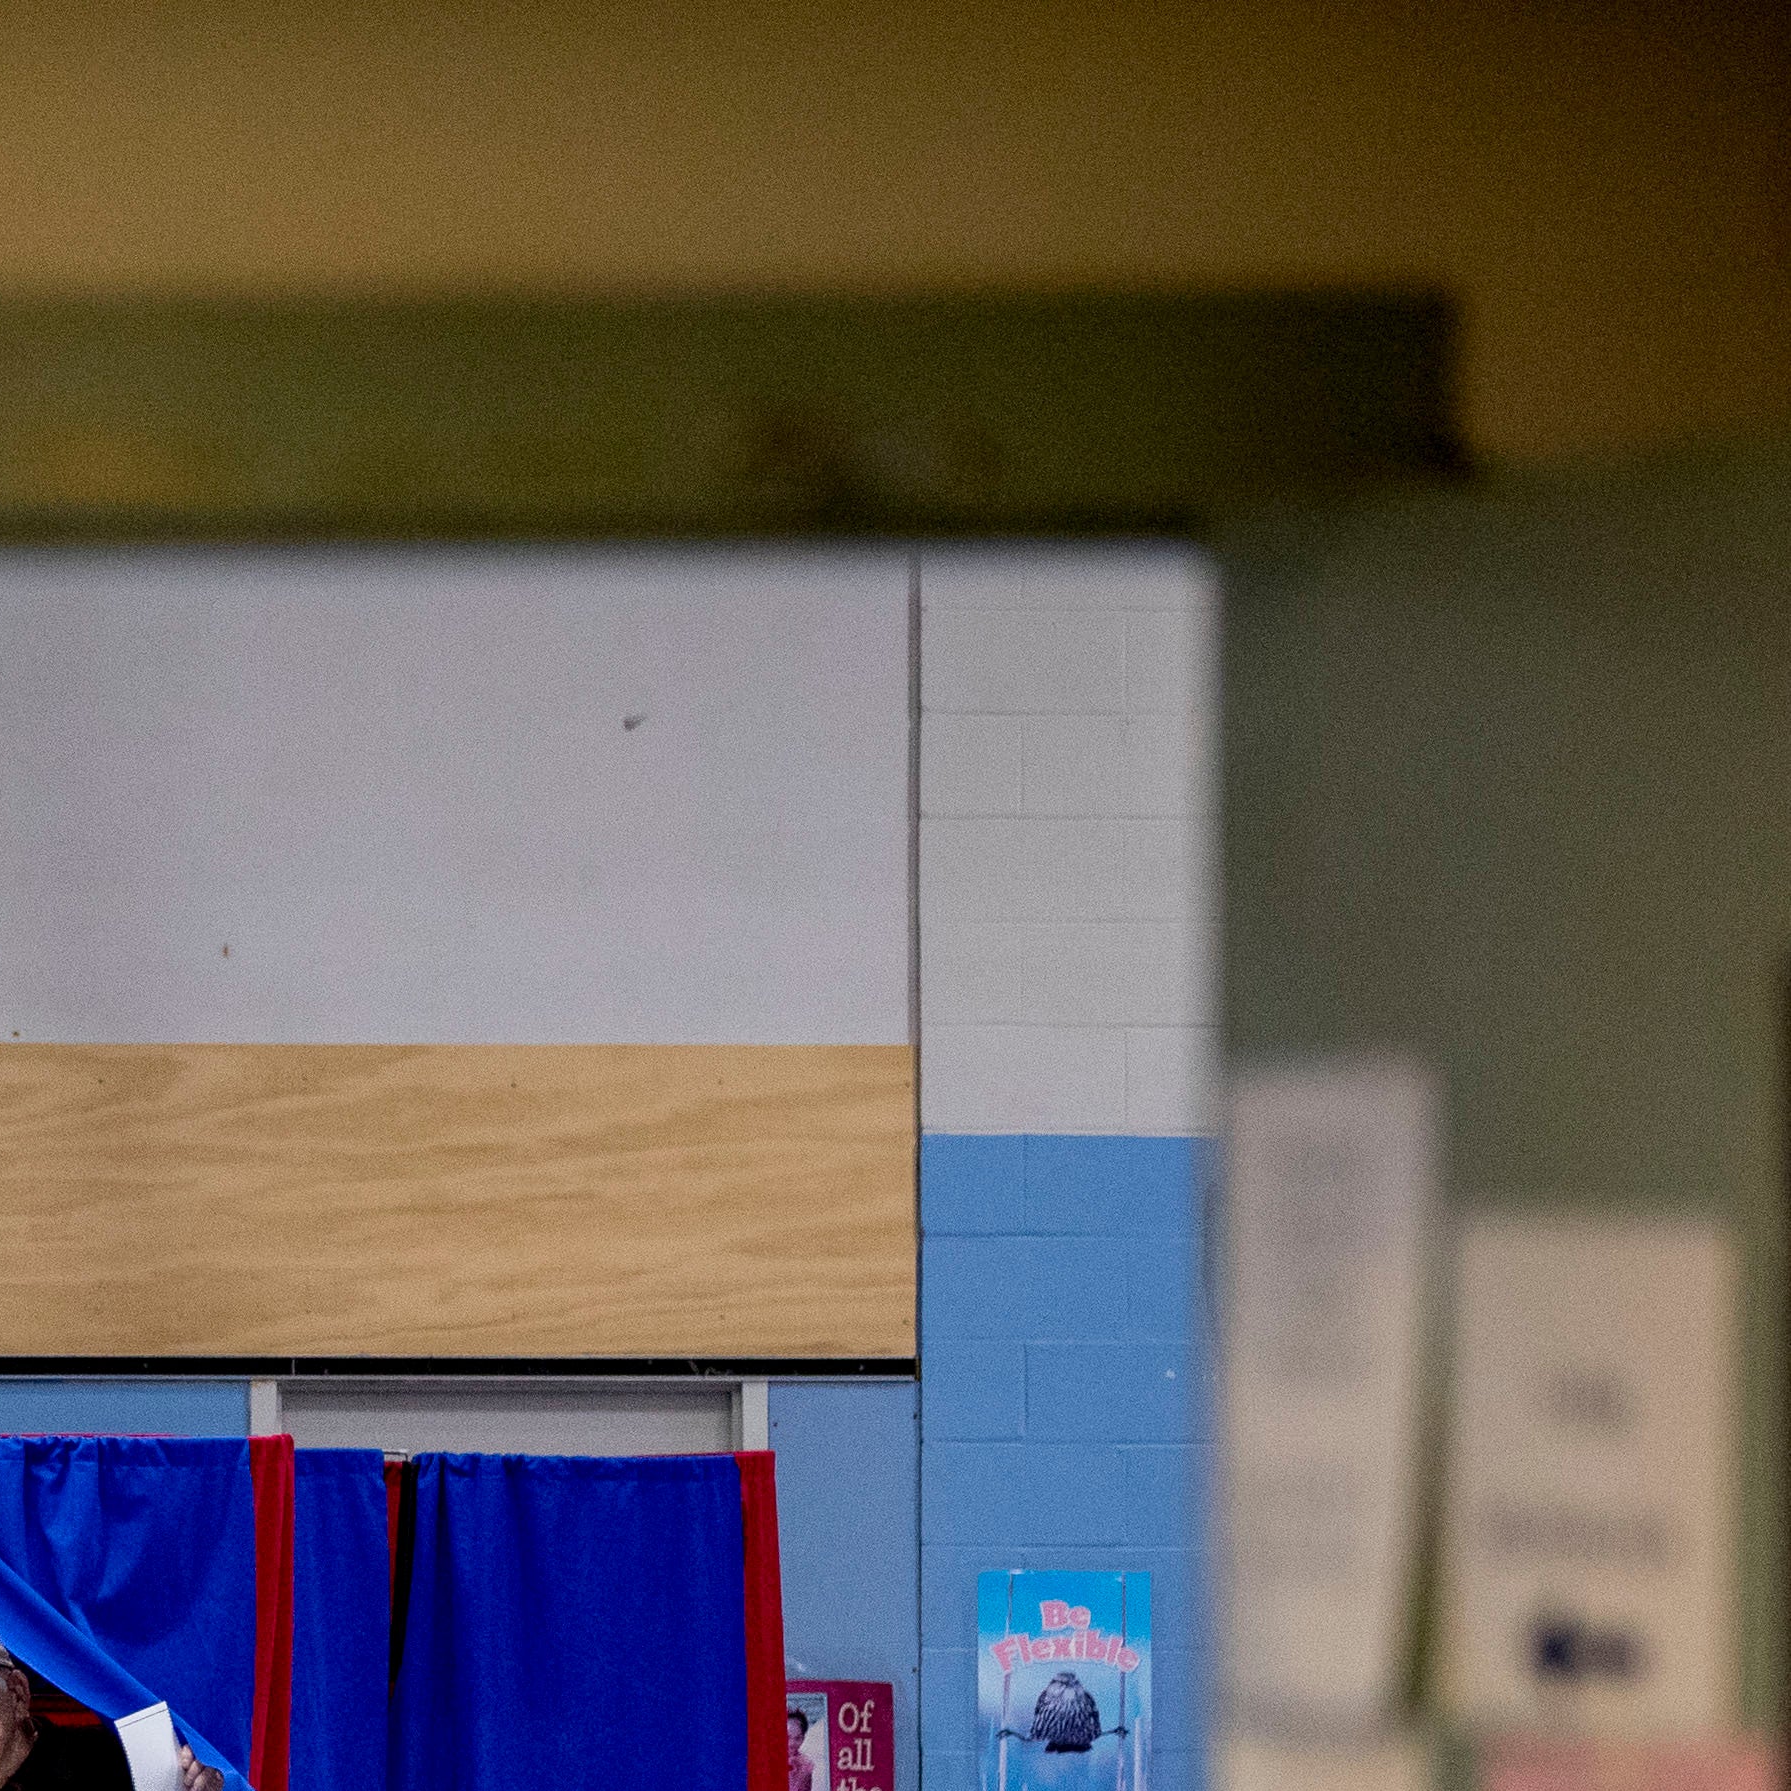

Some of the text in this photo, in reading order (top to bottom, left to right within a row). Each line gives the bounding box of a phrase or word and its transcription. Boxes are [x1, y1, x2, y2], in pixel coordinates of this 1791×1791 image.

[1040, 1600, 1091, 1631] Be
[990, 1628, 1140, 1673] Flexible
[838, 1699, 875, 1733] Of
[837, 1738, 875, 1772] all
